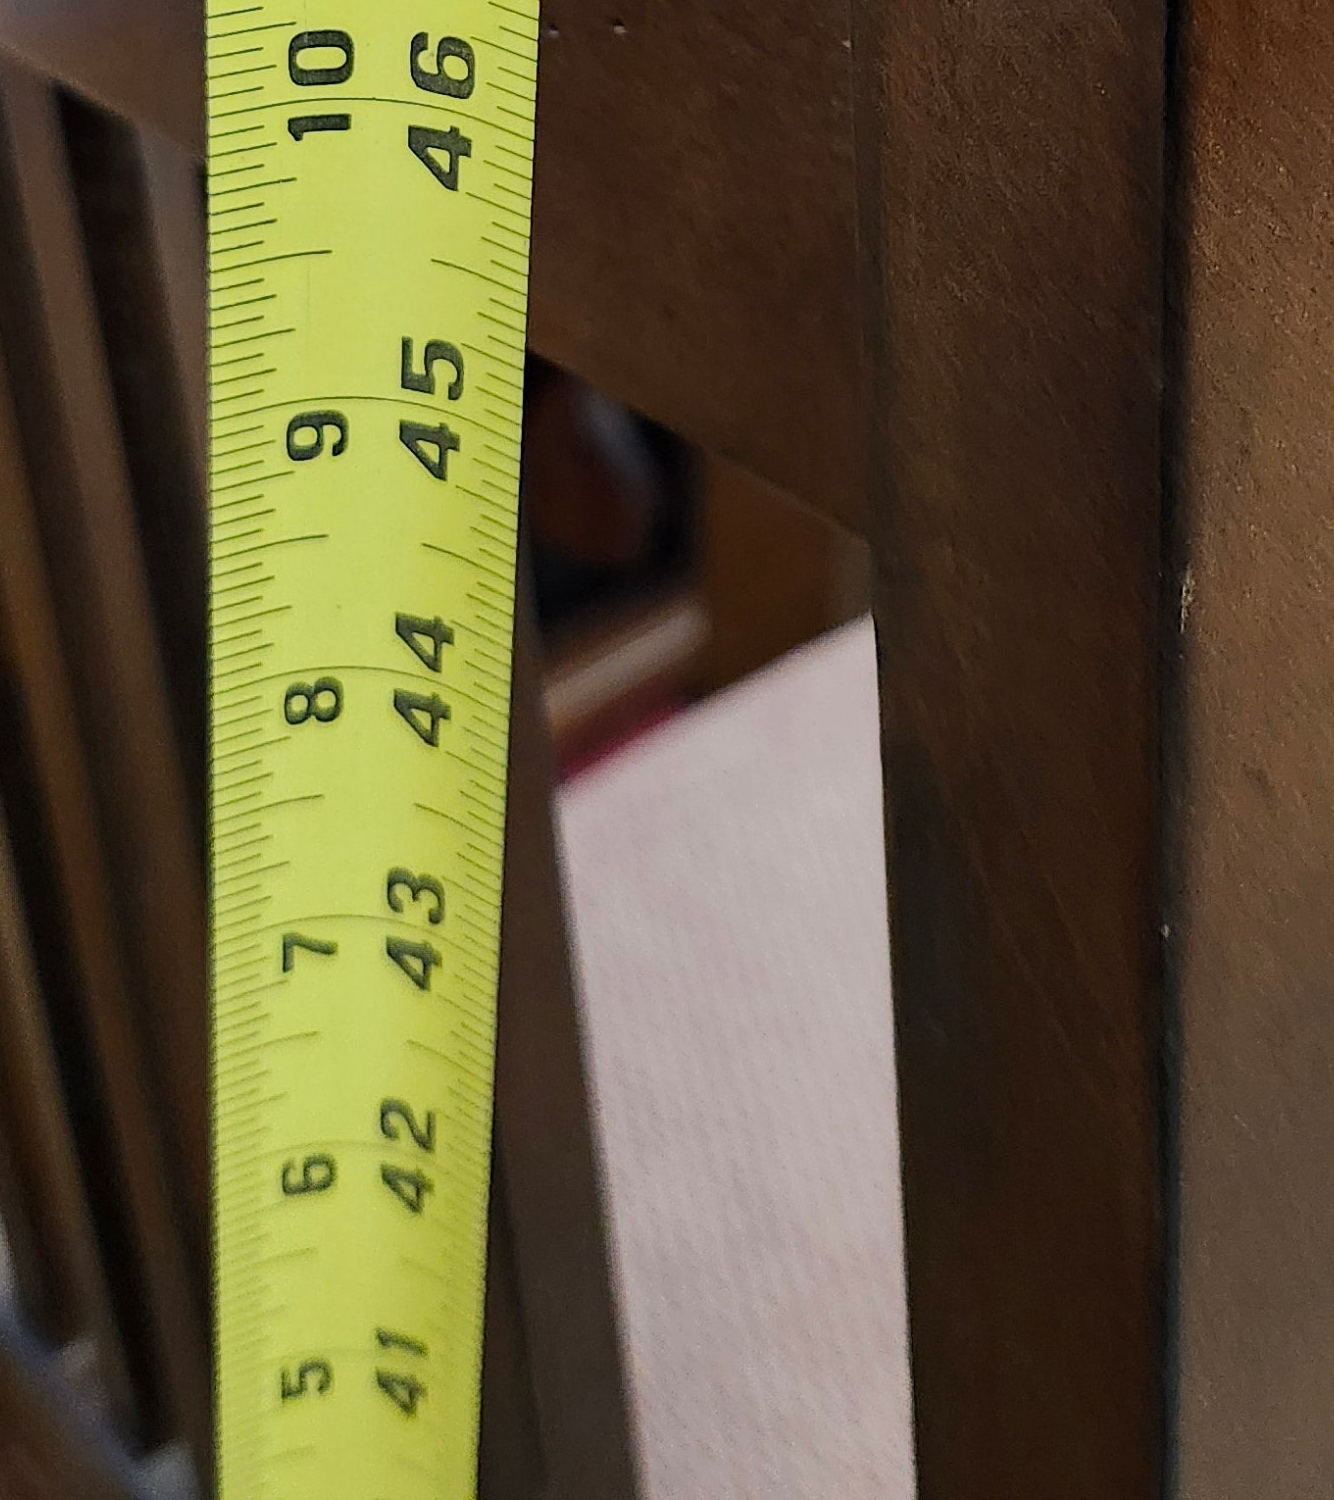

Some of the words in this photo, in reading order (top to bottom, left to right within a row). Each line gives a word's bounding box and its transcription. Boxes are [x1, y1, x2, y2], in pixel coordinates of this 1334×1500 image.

[287, 29, 355, 142] 10
[407, 30, 476, 192] 46
[285, 409, 349, 461] 9
[399, 335, 465, 482] 45
[284, 676, 344, 725] 8
[393, 611, 455, 748] 44
[282, 932, 338, 973] 7
[385, 866, 445, 991] 43
[281, 1152, 338, 1196] 6
[379, 1099, 436, 1215] 42
[280, 1358, 335, 1404] 5
[375, 1328, 429, 1419] 41
